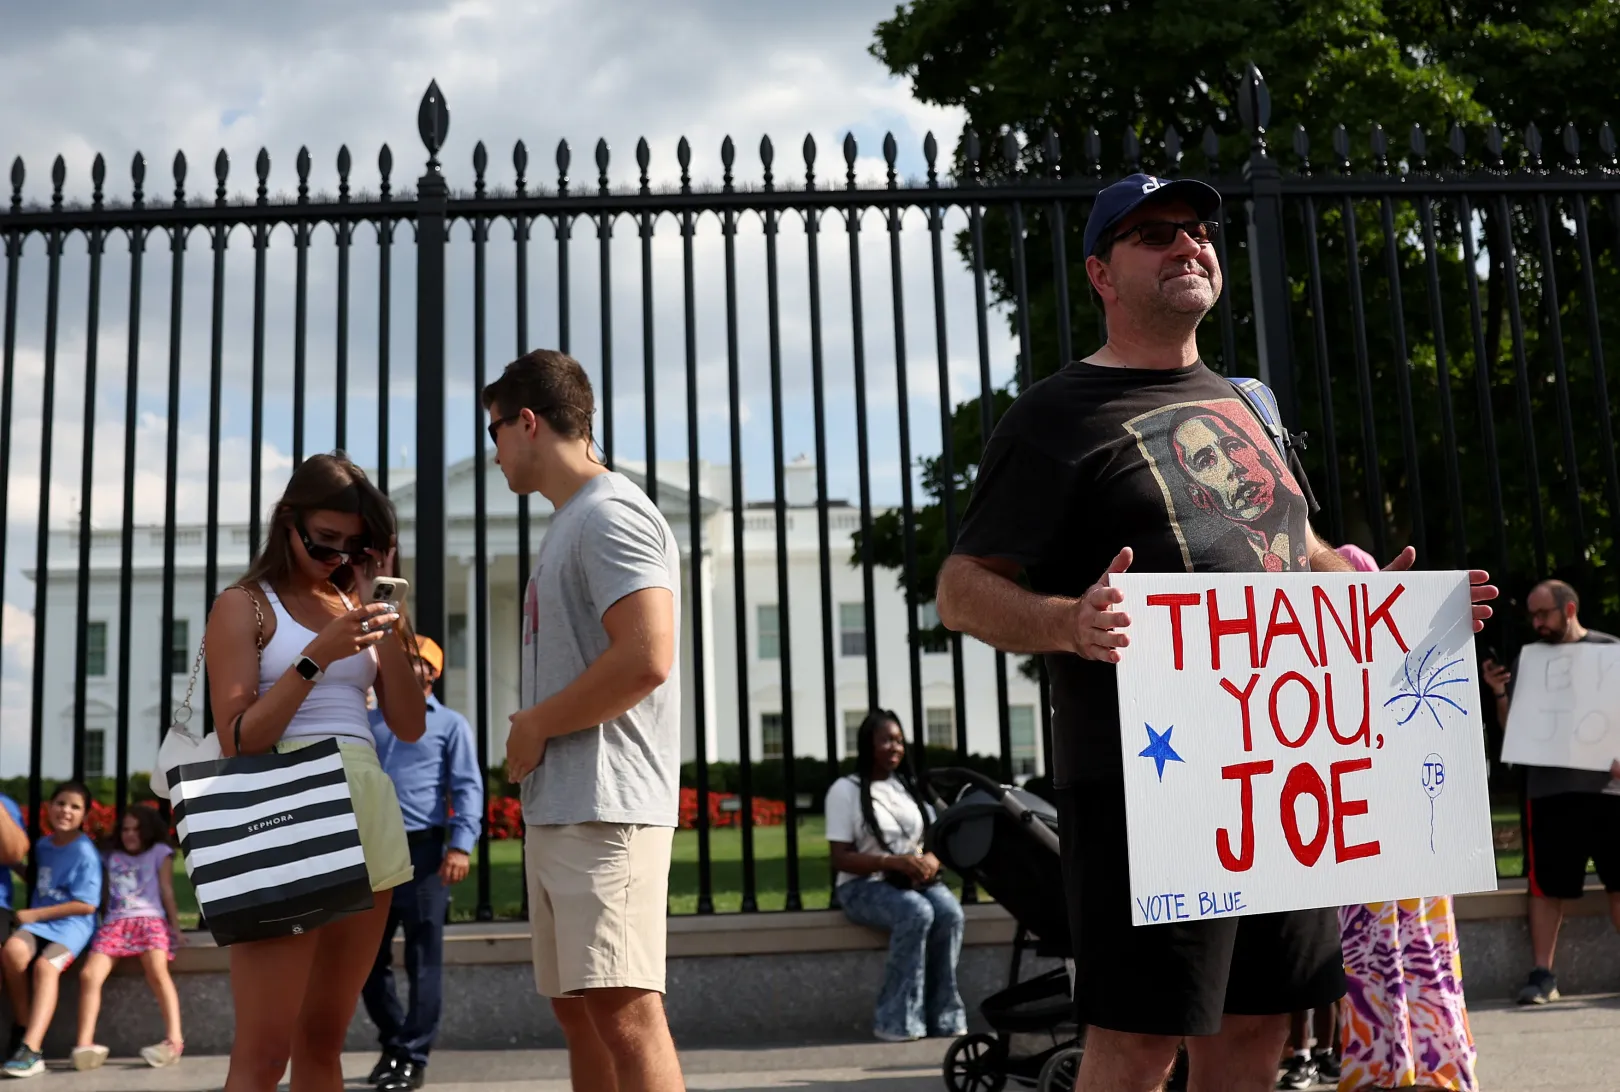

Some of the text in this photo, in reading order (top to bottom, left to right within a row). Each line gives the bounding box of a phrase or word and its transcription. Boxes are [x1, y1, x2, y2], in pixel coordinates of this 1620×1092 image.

[1146, 583, 1410, 671] THANK
[1219, 668, 1384, 752] YOU,
[1422, 762, 1445, 787] JB
[247, 813, 294, 833] SEPHORA
[1216, 757, 1381, 872] JOE
[1136, 891, 1247, 923] VOTE BLUE
